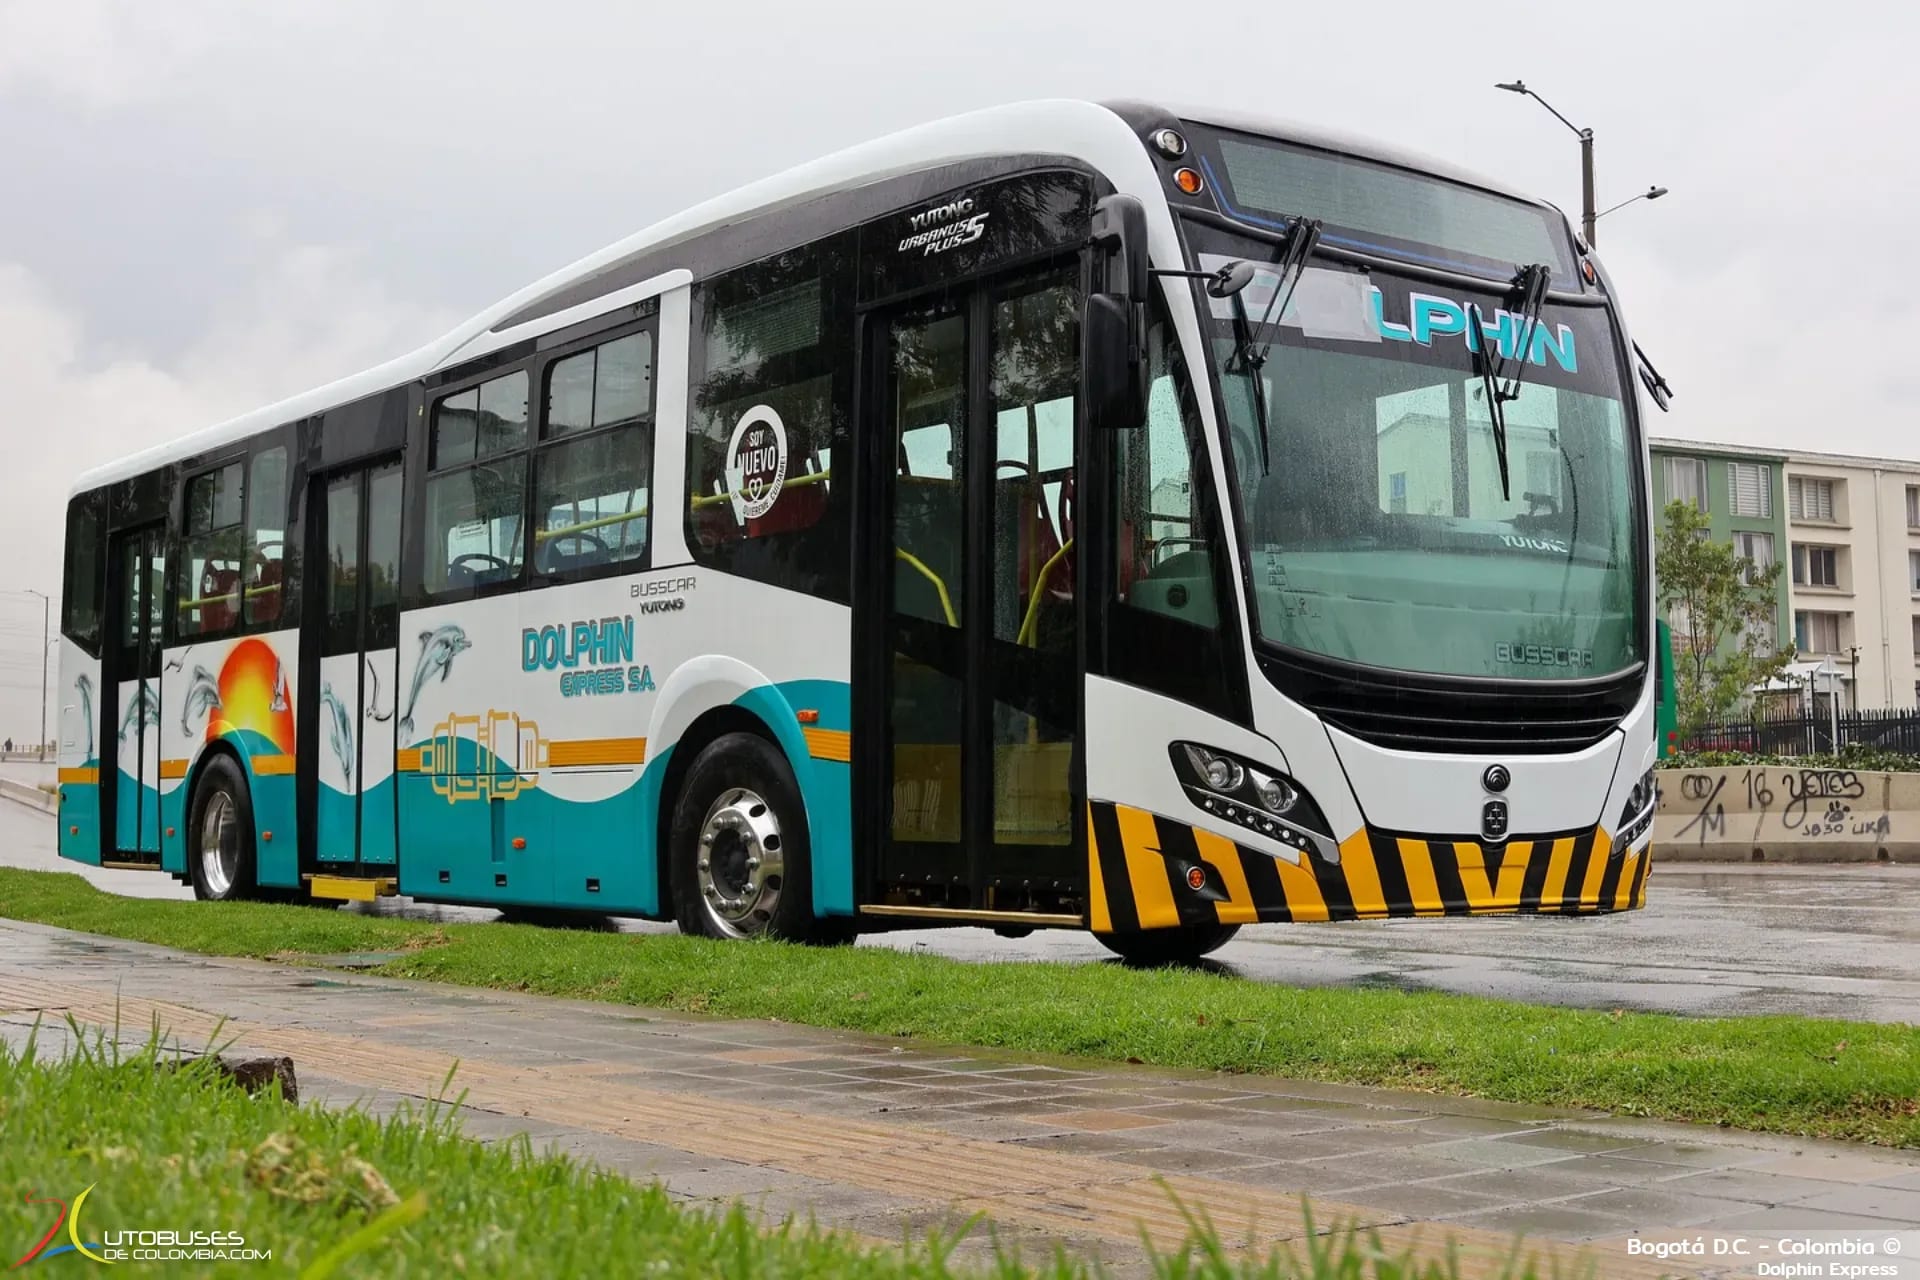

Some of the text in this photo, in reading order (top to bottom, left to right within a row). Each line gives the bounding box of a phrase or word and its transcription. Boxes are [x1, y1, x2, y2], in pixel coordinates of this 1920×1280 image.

[910, 198, 973, 231] YUTONG
[923, 232, 965, 256] PLUS
[749, 429, 765, 447] SOY
[738, 445, 776, 476] NUEVO
[631, 576, 697, 598] BUSSCAR
[639, 598, 685, 614] YUTONG
[522, 614, 634, 672] DOLPHIN
[1494, 641, 1593, 669] BUSSCAR
[560, 667, 625, 697] EXPRESS
